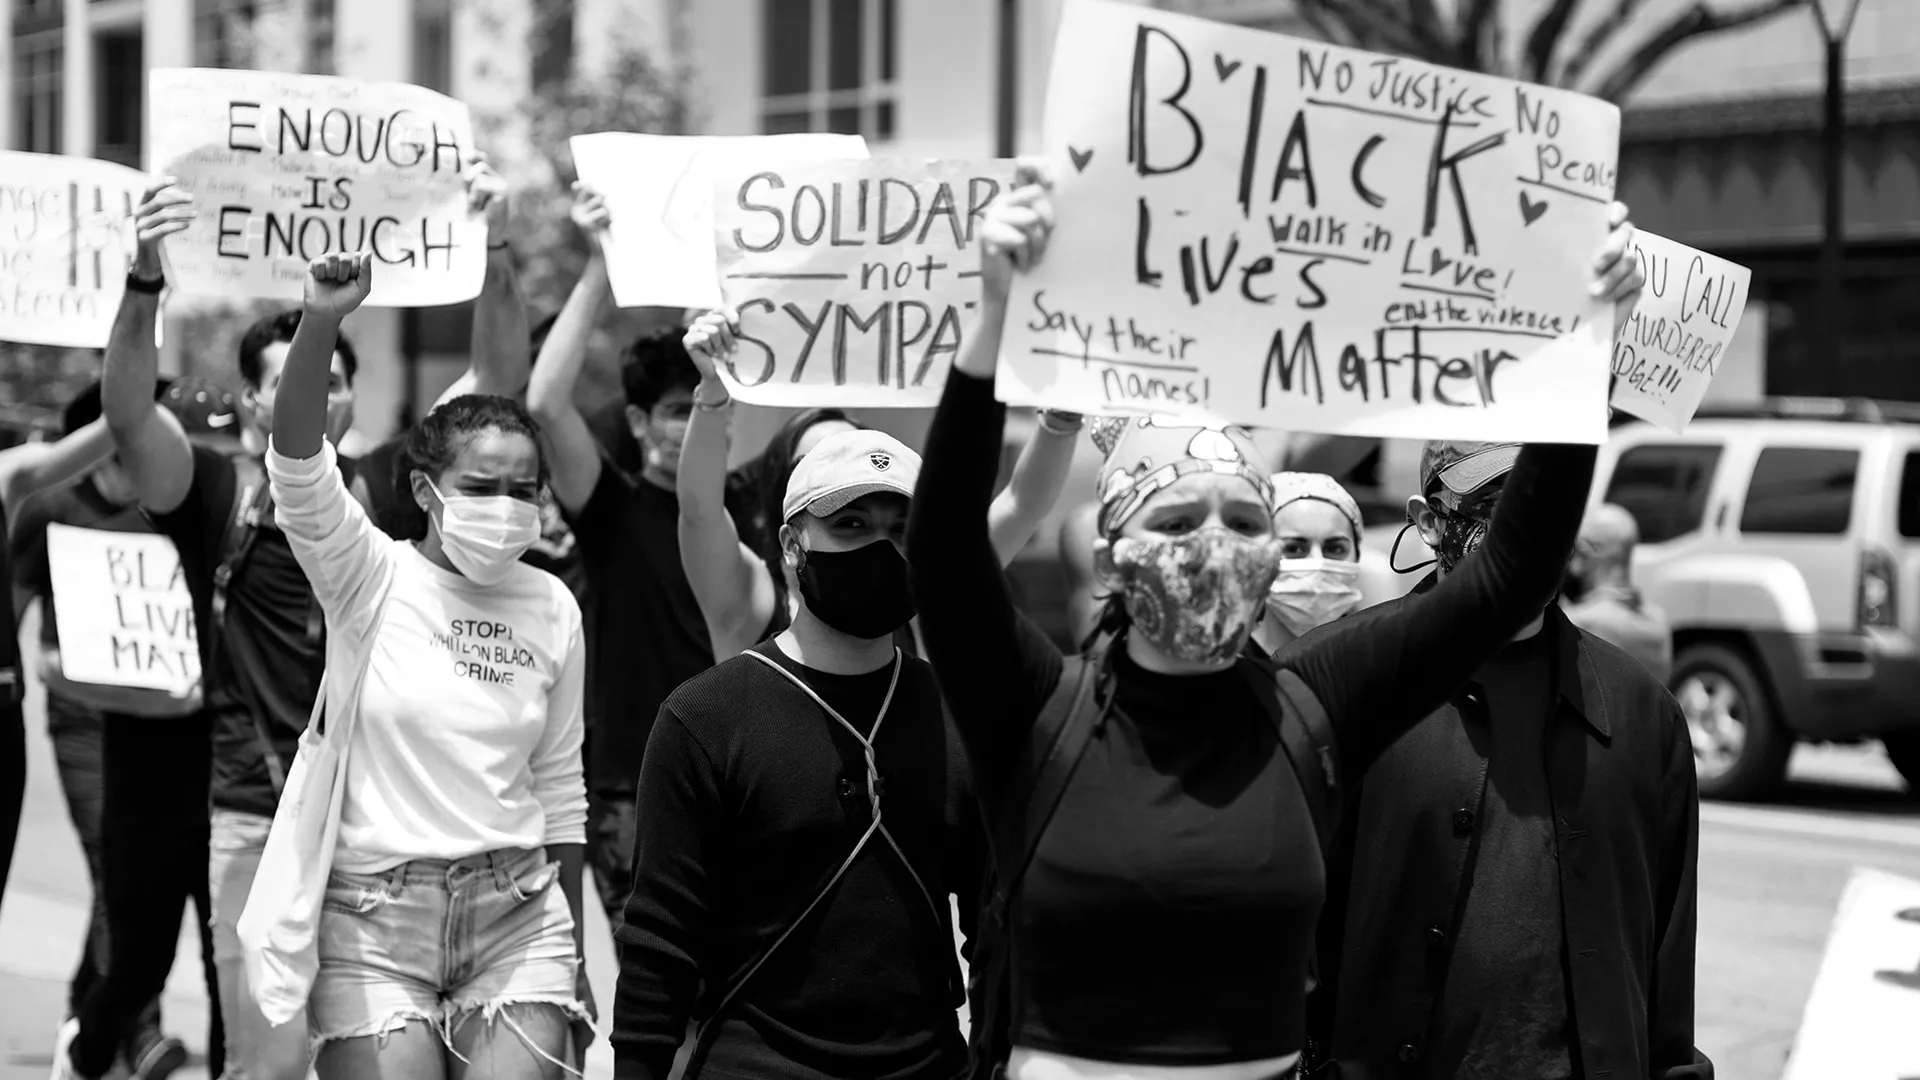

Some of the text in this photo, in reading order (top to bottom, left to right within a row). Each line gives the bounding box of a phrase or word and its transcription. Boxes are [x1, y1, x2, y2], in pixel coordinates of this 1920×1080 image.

[229, 101, 461, 173] ENOUGH
[301, 175, 354, 211] IS
[732, 171, 1004, 253] SOLIDAR
[217, 205, 461, 271] ENOUGH
[1363, 223, 1392, 252] in
[860, 255, 947, 290] not
[1681, 255, 1736, 330] CALL
[726, 297, 976, 390] SYMPA
[1028, 290, 1197, 369] Say their
[1384, 300, 1426, 323] end
[1433, 298, 1471, 322] the
[1260, 320, 1520, 408] Matter
[1621, 311, 1723, 377] MURDERER
[454, 660, 515, 688] CRIME
[494, 645, 536, 669] BLACK
